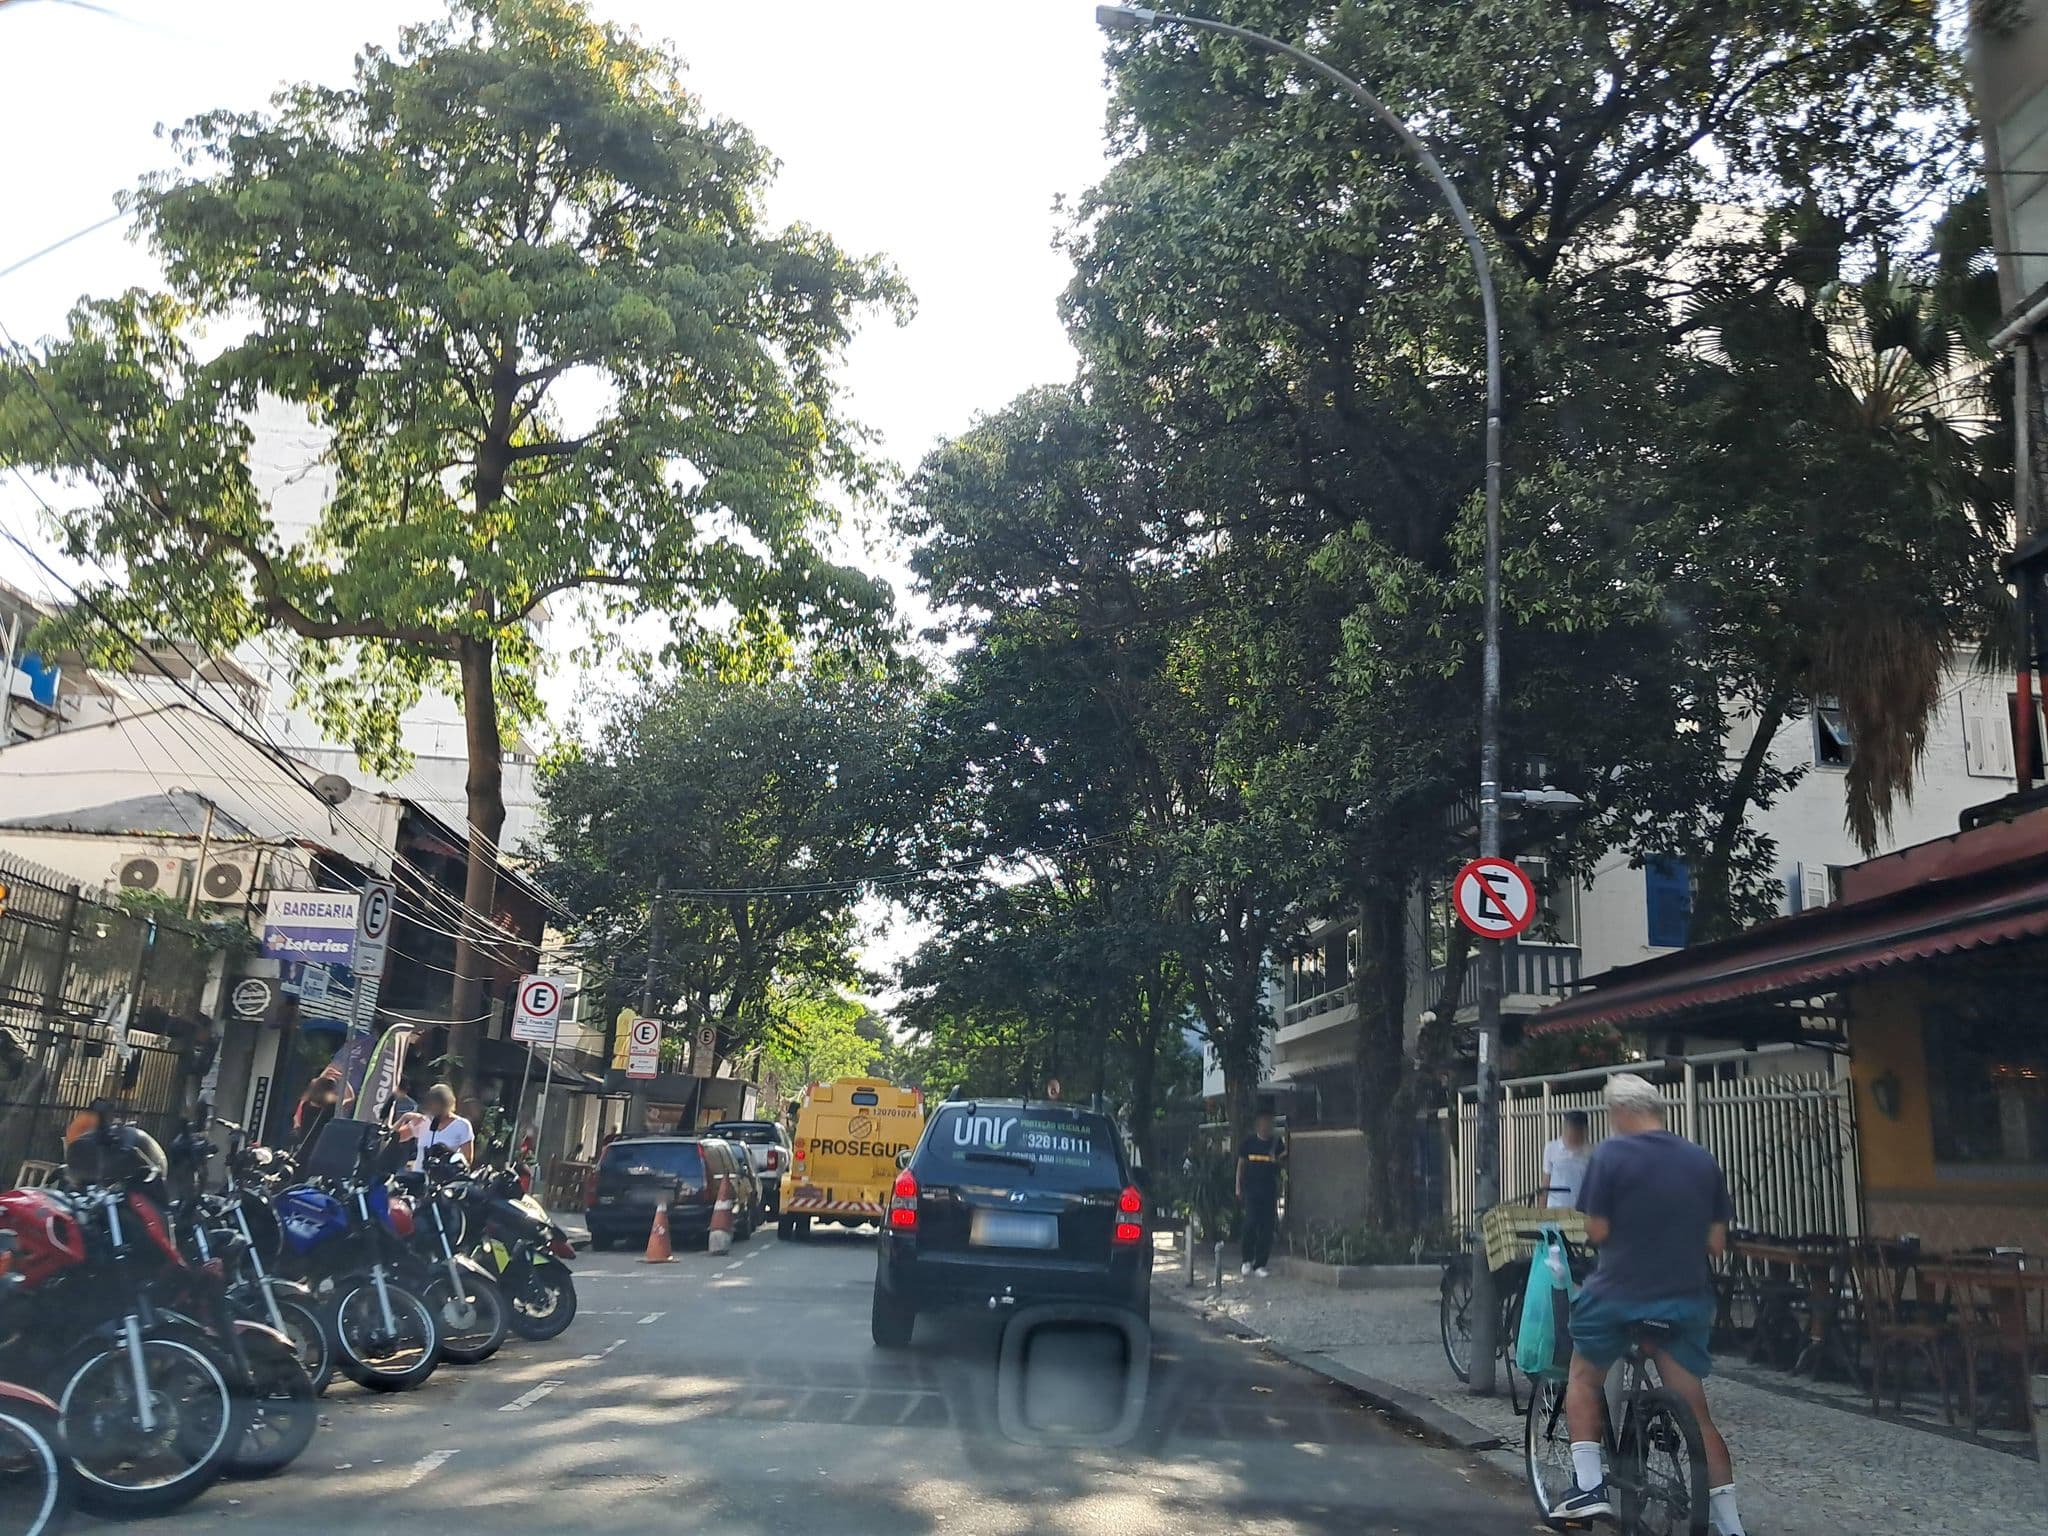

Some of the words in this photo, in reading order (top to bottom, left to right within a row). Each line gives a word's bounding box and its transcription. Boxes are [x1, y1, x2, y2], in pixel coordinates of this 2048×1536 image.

[1479, 873, 1510, 921] E
[283, 901, 353, 919] BARBEARIA
[369, 897, 383, 929] E
[284, 938, 350, 954] Loterias
[533, 988, 548, 1009] E
[641, 1026, 651, 1040] E
[703, 1031, 710, 1042] E
